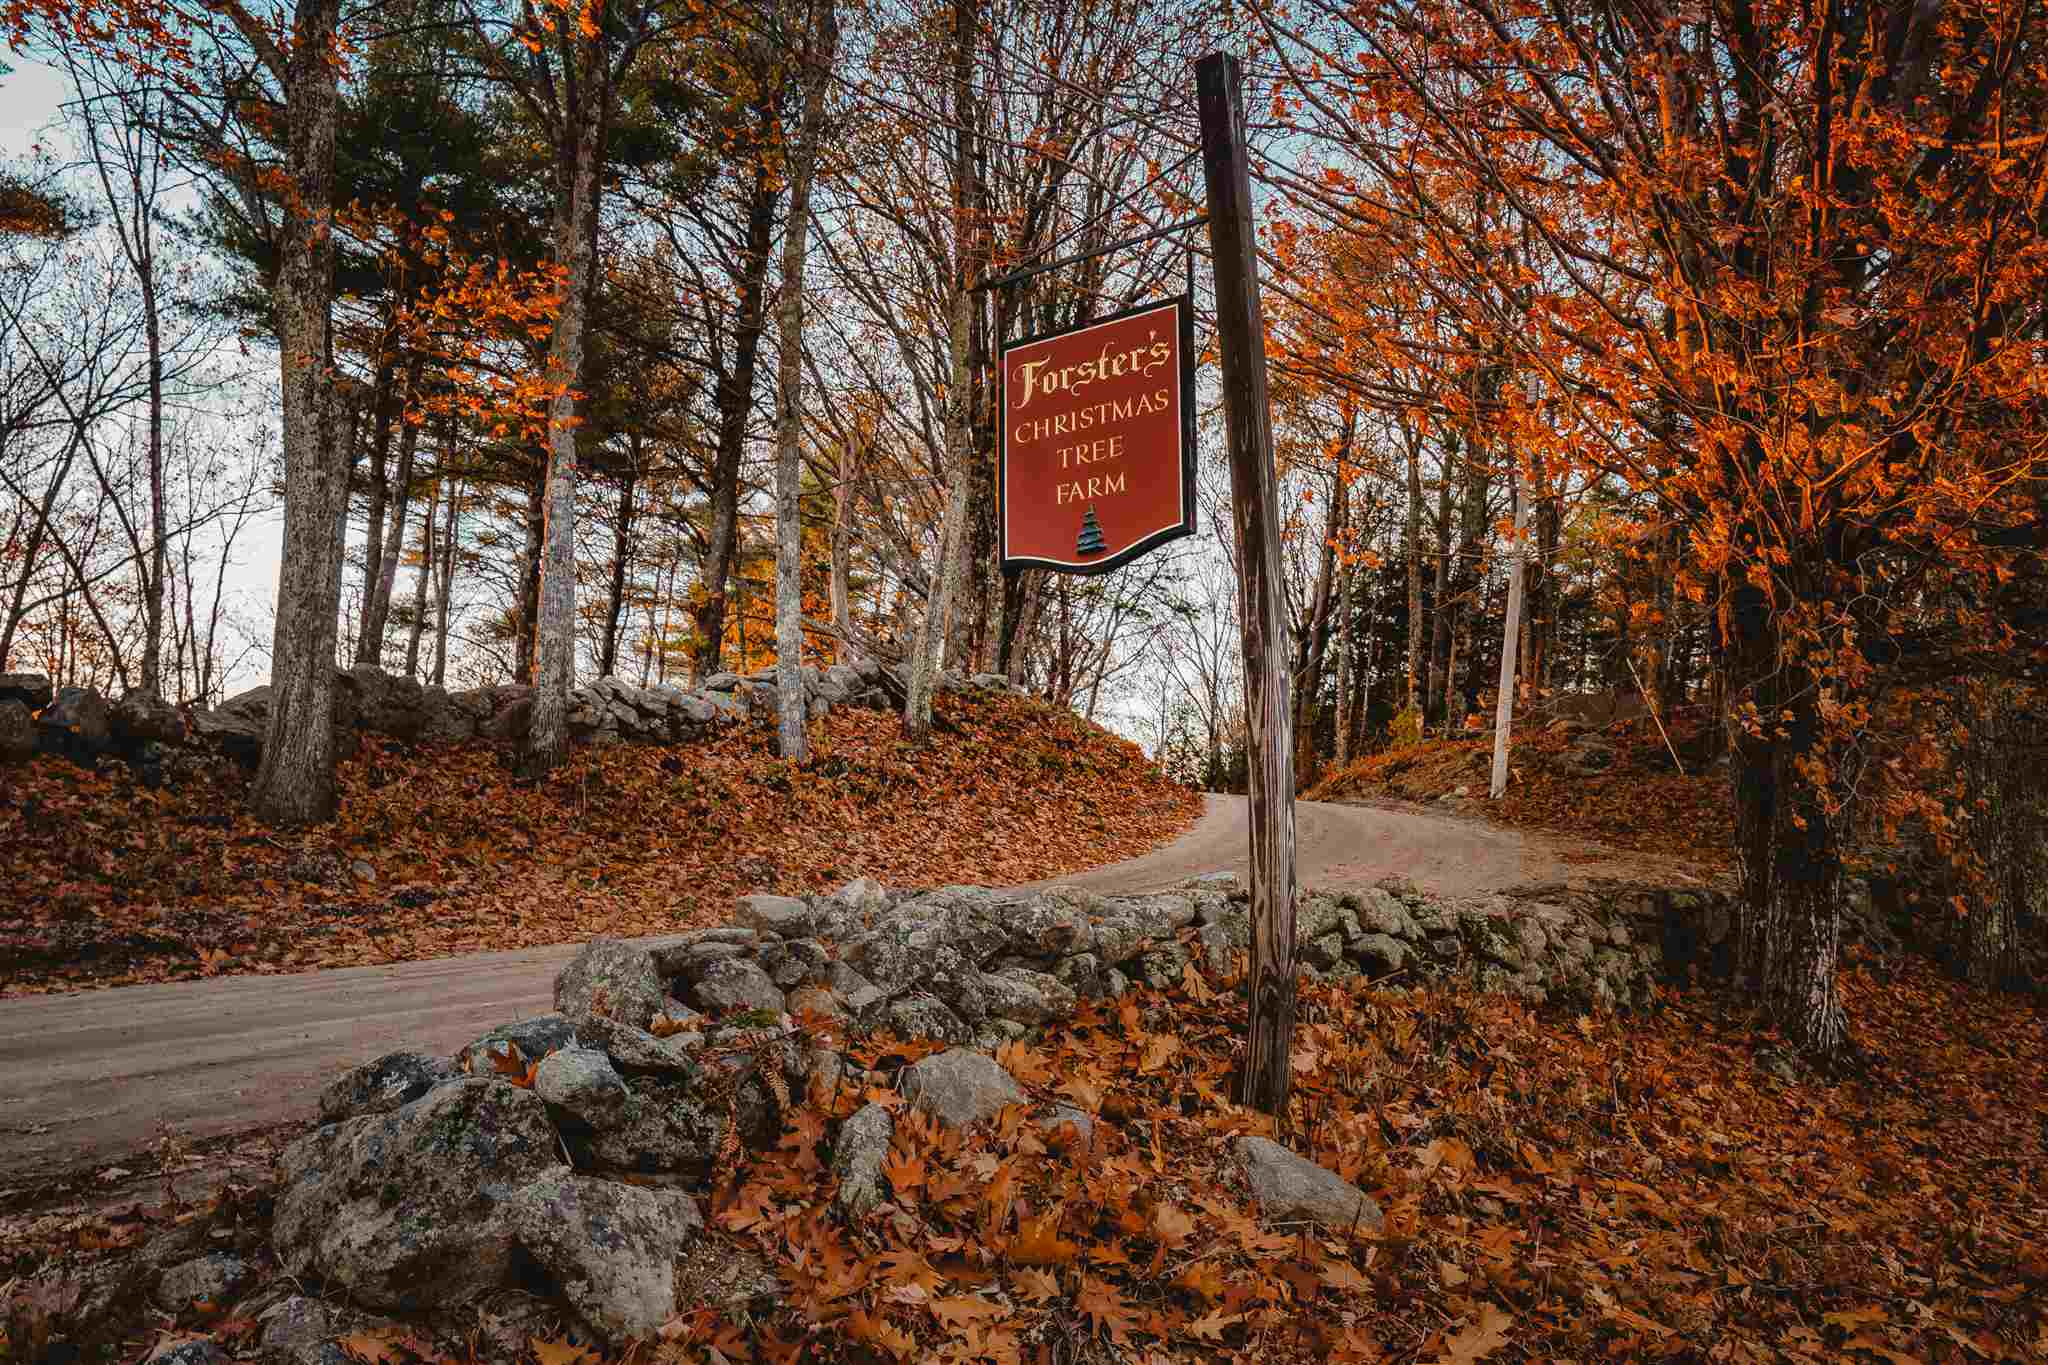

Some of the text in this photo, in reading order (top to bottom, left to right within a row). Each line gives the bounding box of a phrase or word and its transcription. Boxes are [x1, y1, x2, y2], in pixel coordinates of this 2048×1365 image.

[1012, 330, 1171, 409] Forster's
[1015, 388, 1169, 443] CHRISTMAS
[1056, 435, 1125, 469] TREE
[1056, 471, 1127, 505] FARM
